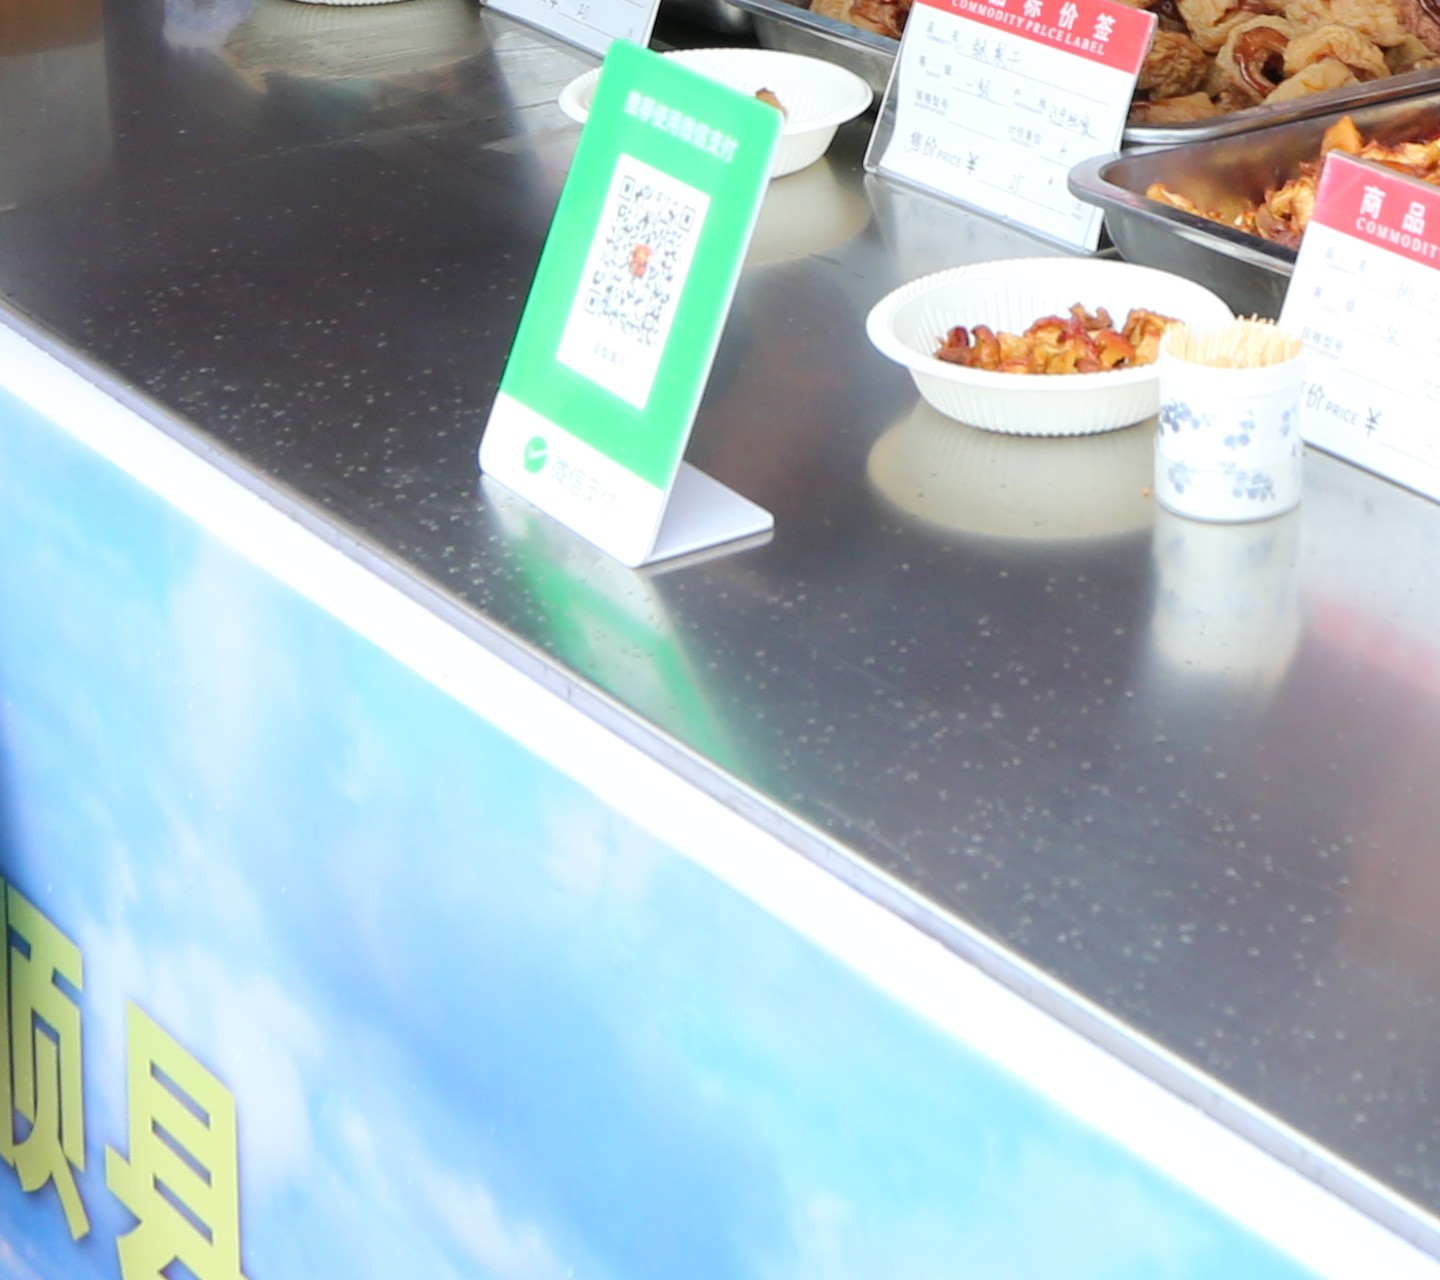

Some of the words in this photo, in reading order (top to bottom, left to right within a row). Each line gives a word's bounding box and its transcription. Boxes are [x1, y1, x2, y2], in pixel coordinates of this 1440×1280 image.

[1063, 29, 1105, 57] LABEL
[623, 89, 740, 163] 推荐使用微信支付
[936, 149, 962, 168] PRICE
[1325, 401, 1359, 425] PRICE
